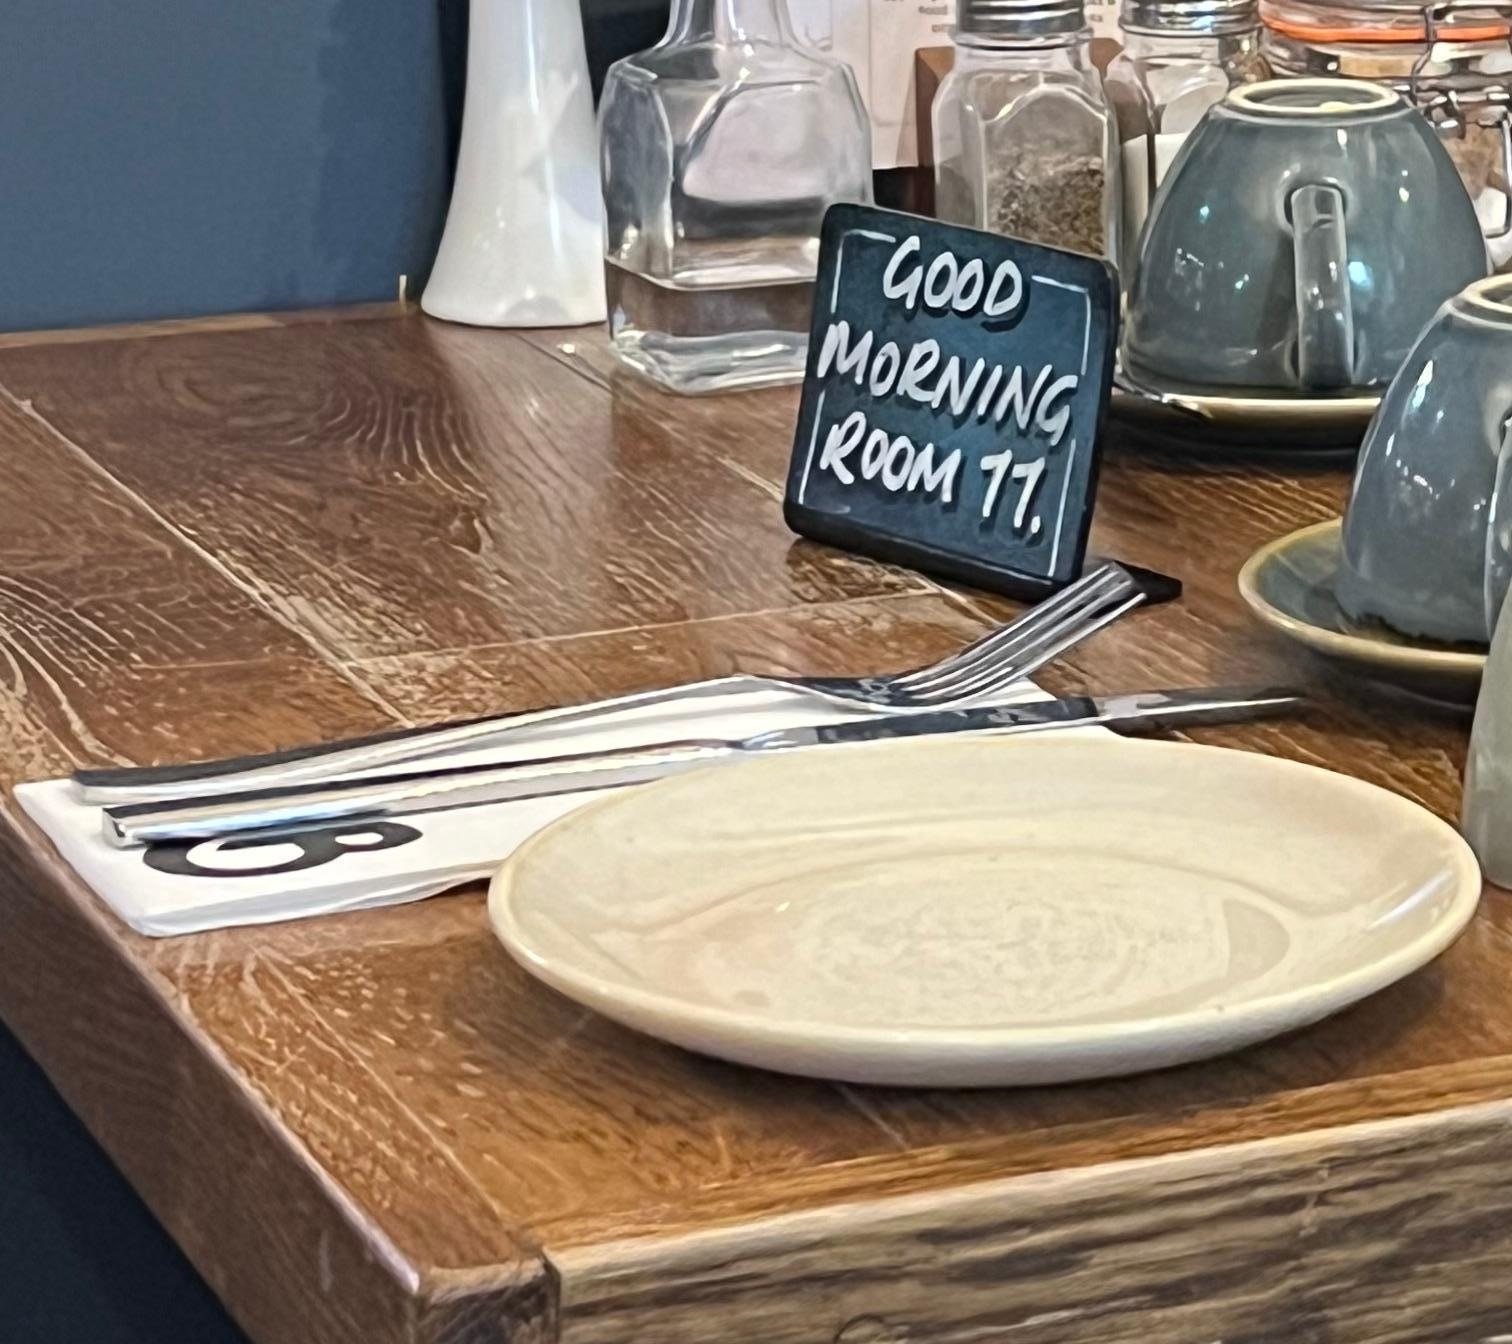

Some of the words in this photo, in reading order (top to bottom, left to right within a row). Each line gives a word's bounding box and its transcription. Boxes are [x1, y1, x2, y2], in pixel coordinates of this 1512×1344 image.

[882, 234, 1024, 317] GOOD
[816, 319, 1079, 447] MORNING
[819, 410, 962, 504] ROOM
